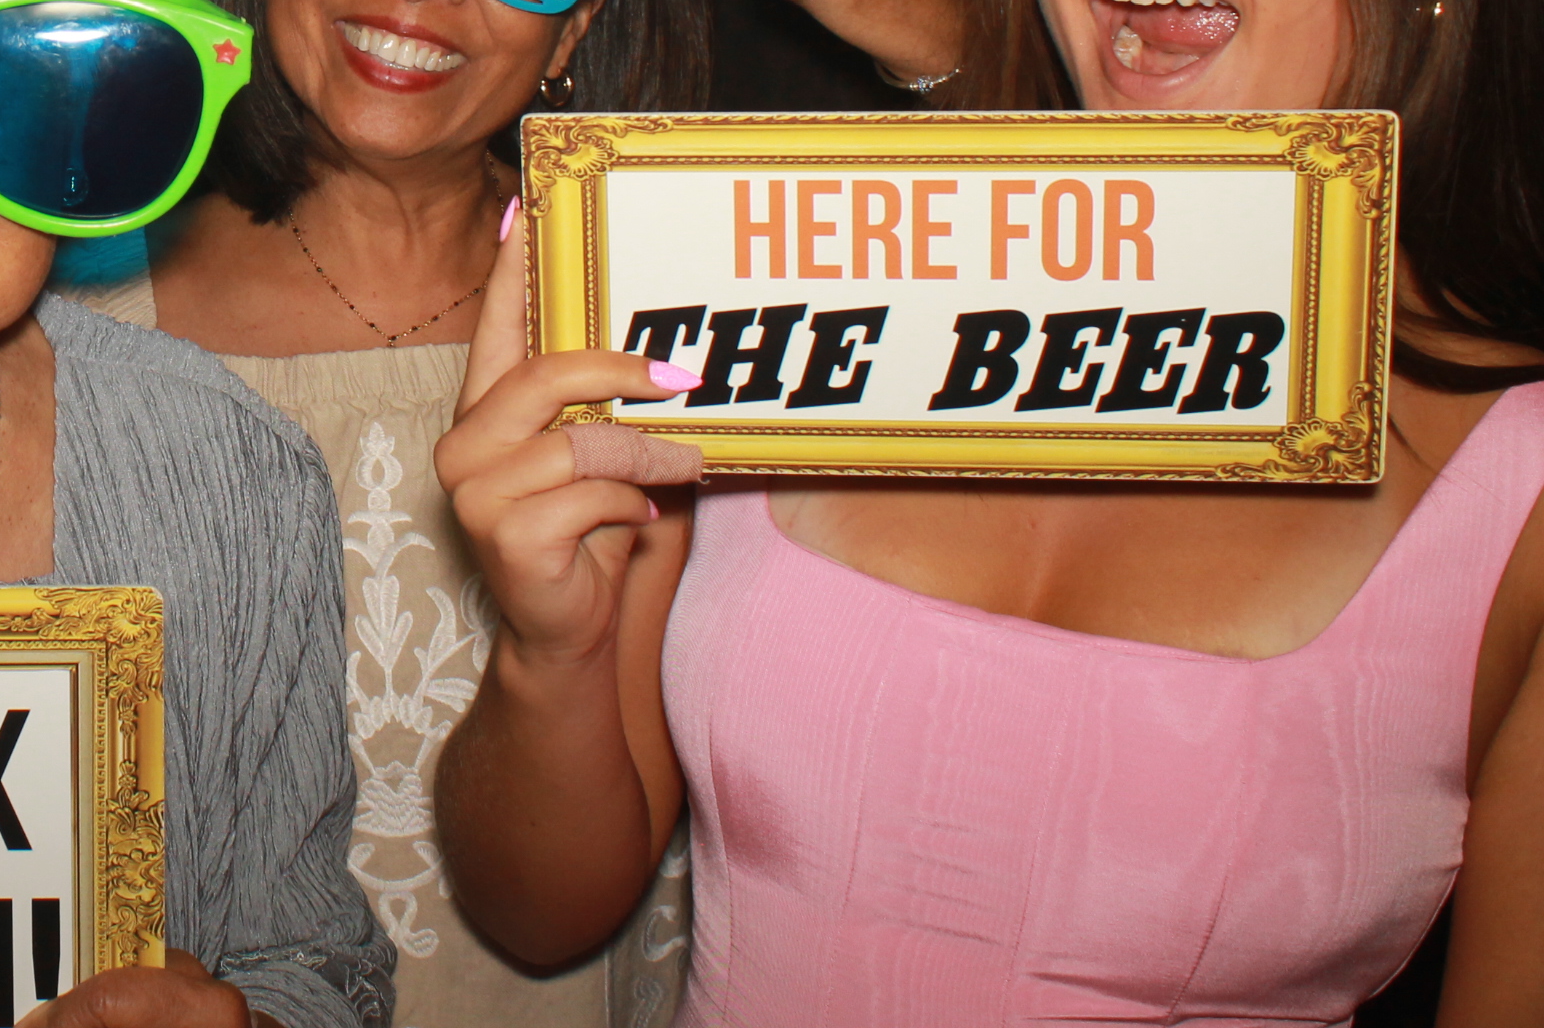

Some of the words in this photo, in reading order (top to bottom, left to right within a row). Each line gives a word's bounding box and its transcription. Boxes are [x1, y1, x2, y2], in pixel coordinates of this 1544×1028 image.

[734, 180, 957, 279] HERE
[990, 179, 1154, 281] FOR
[620, 304, 888, 408] THE
[930, 308, 1284, 414] BEER
